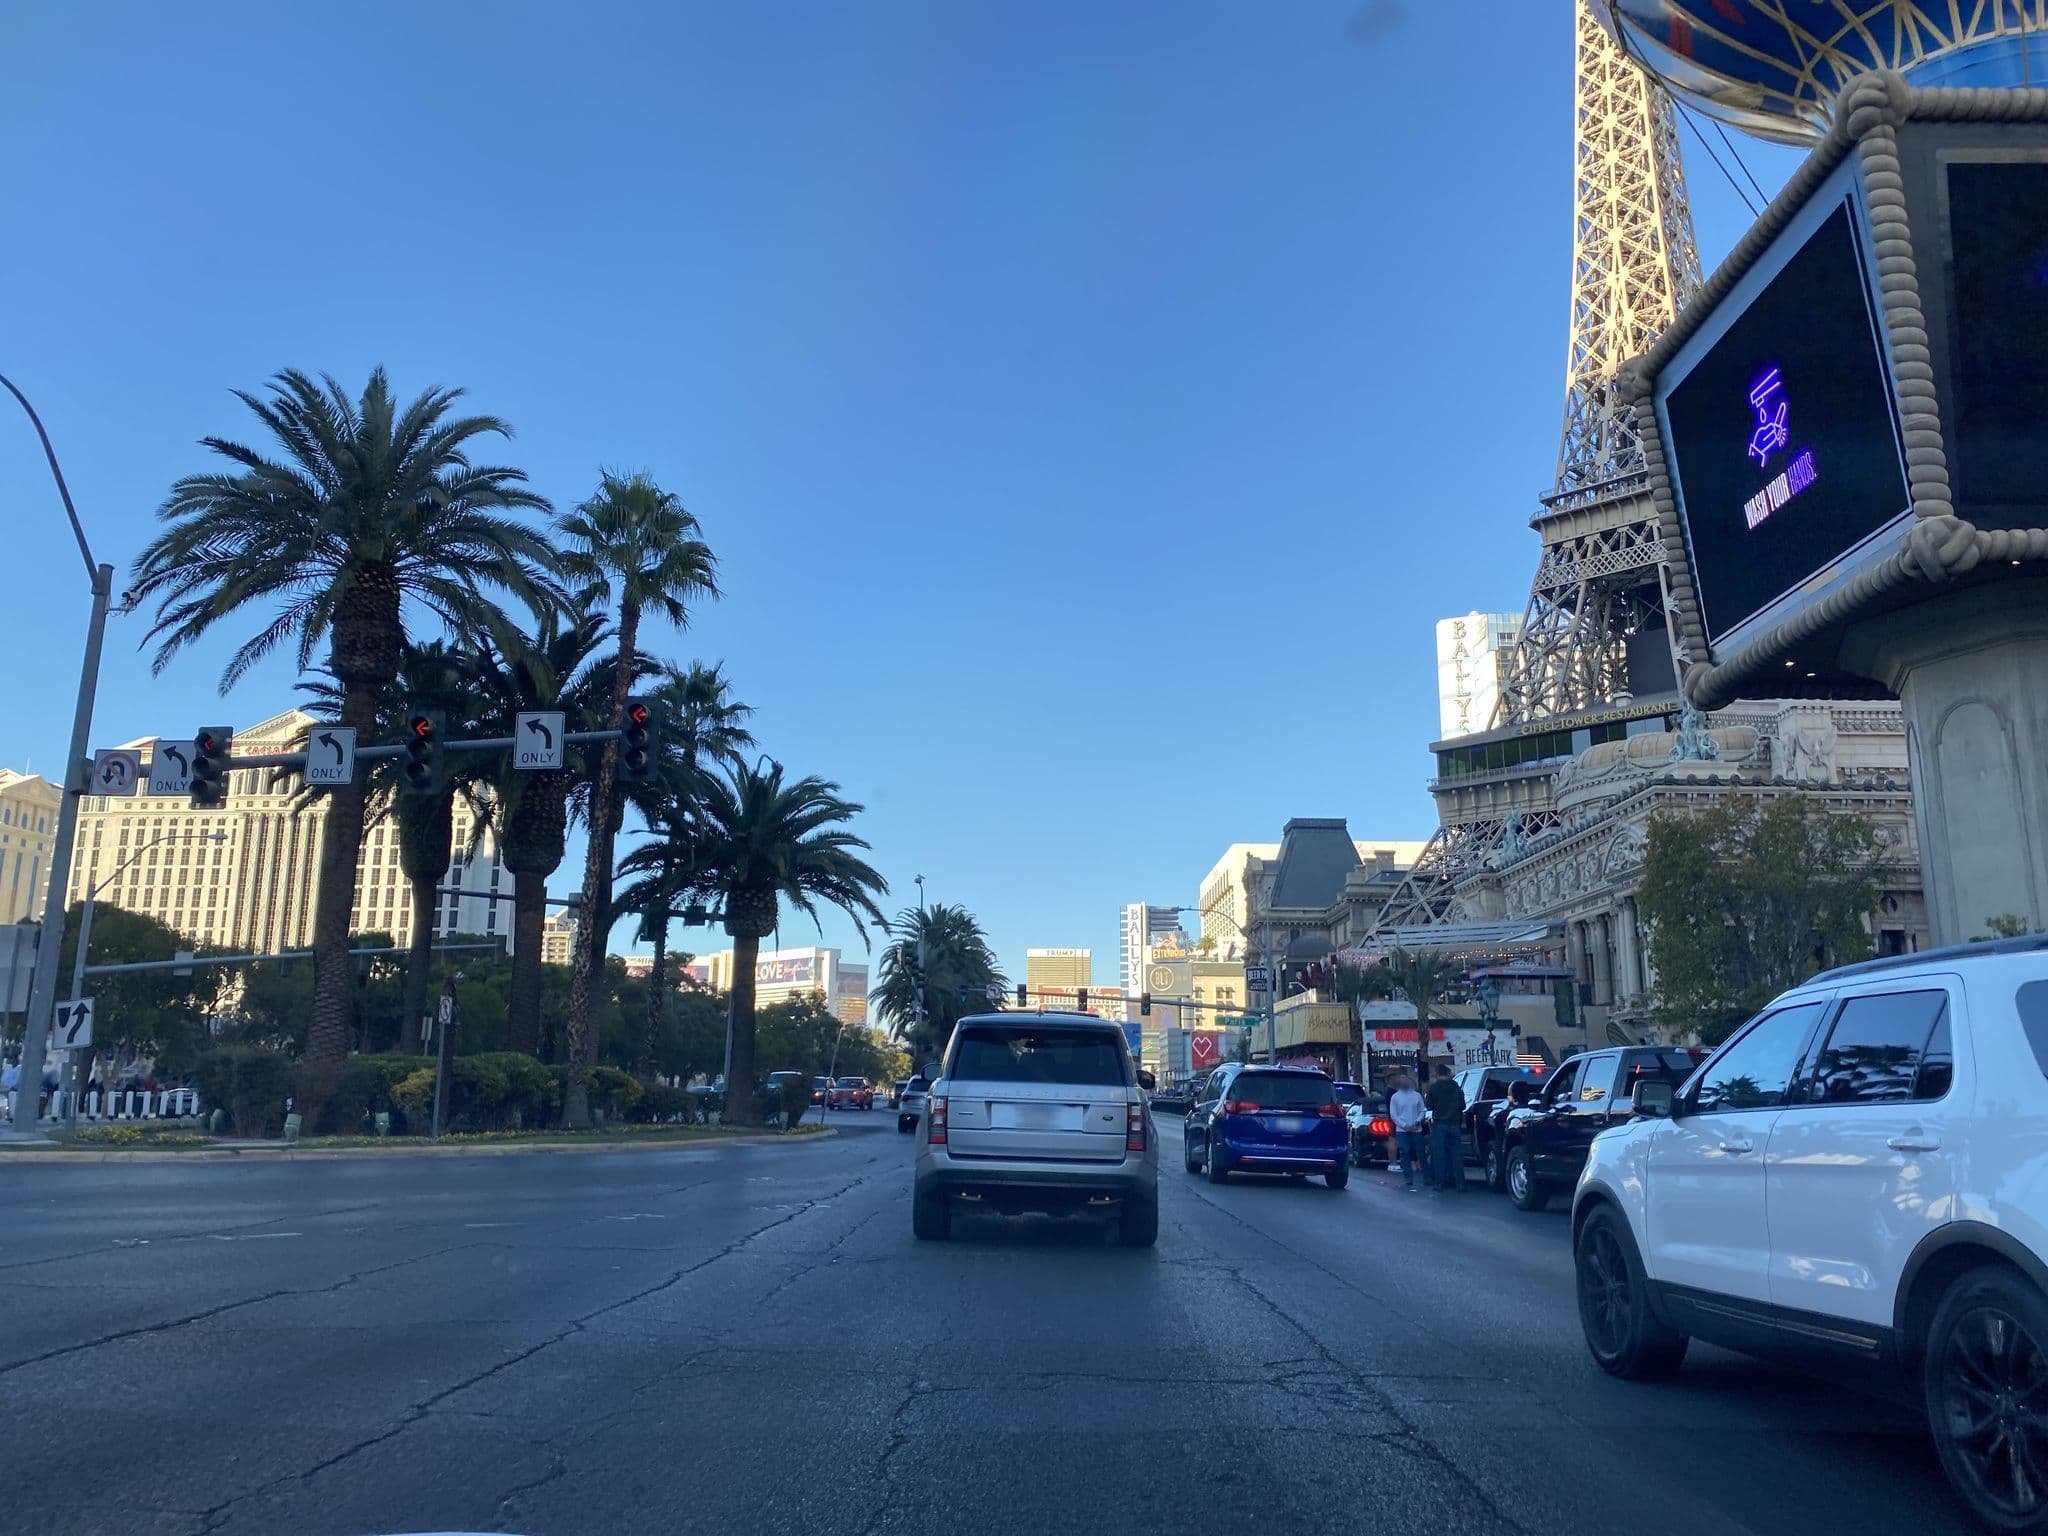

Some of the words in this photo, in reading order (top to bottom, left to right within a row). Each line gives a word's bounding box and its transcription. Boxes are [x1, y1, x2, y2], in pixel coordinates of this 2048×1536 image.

[1744, 489, 1769, 529] WASH
[1766, 472, 1790, 512] YOUR
[1522, 721, 1556, 736] EIFFEL
[1560, 713, 1599, 729] TOWER
[1604, 701, 1673, 721] RESTAURANT
[522, 752, 554, 763] ONLY
[311, 768, 343, 779] ONLY
[156, 781, 188, 792] ONLY
[755, 962, 784, 981] LOVE
[1248, 970, 1260, 980] BEER
[1155, 971, 1169, 985] BLT
[1224, 1017, 1245, 1025] Paris
[1466, 1049, 1488, 1065] BEER
